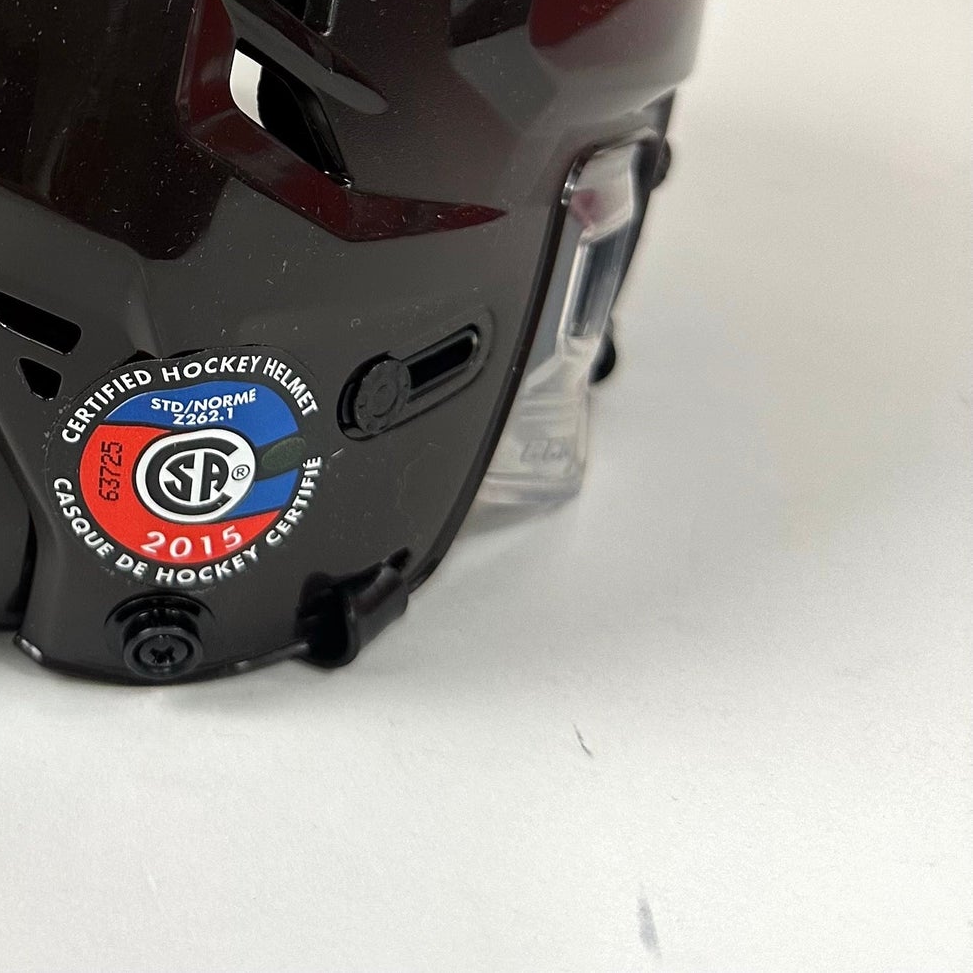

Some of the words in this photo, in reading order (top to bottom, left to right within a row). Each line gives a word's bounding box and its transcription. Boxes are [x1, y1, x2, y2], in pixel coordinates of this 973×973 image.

[61, 369, 152, 444] CERTIFIED
[161, 355, 262, 383] HOCKEY
[263, 356, 320, 417] HELMET
[150, 388, 257, 414] STD/NORME
[172, 408, 234, 426] Z262.1
[98, 441, 123, 502] 63725
[145, 437, 239, 515] CSA
[53, 477, 115, 557] CASQUE
[115, 553, 148, 576] DE
[155, 544, 260, 586] HOCKEY
[265, 455, 323, 547] CERTIFIÉ
[140, 525, 243, 559] 2015
